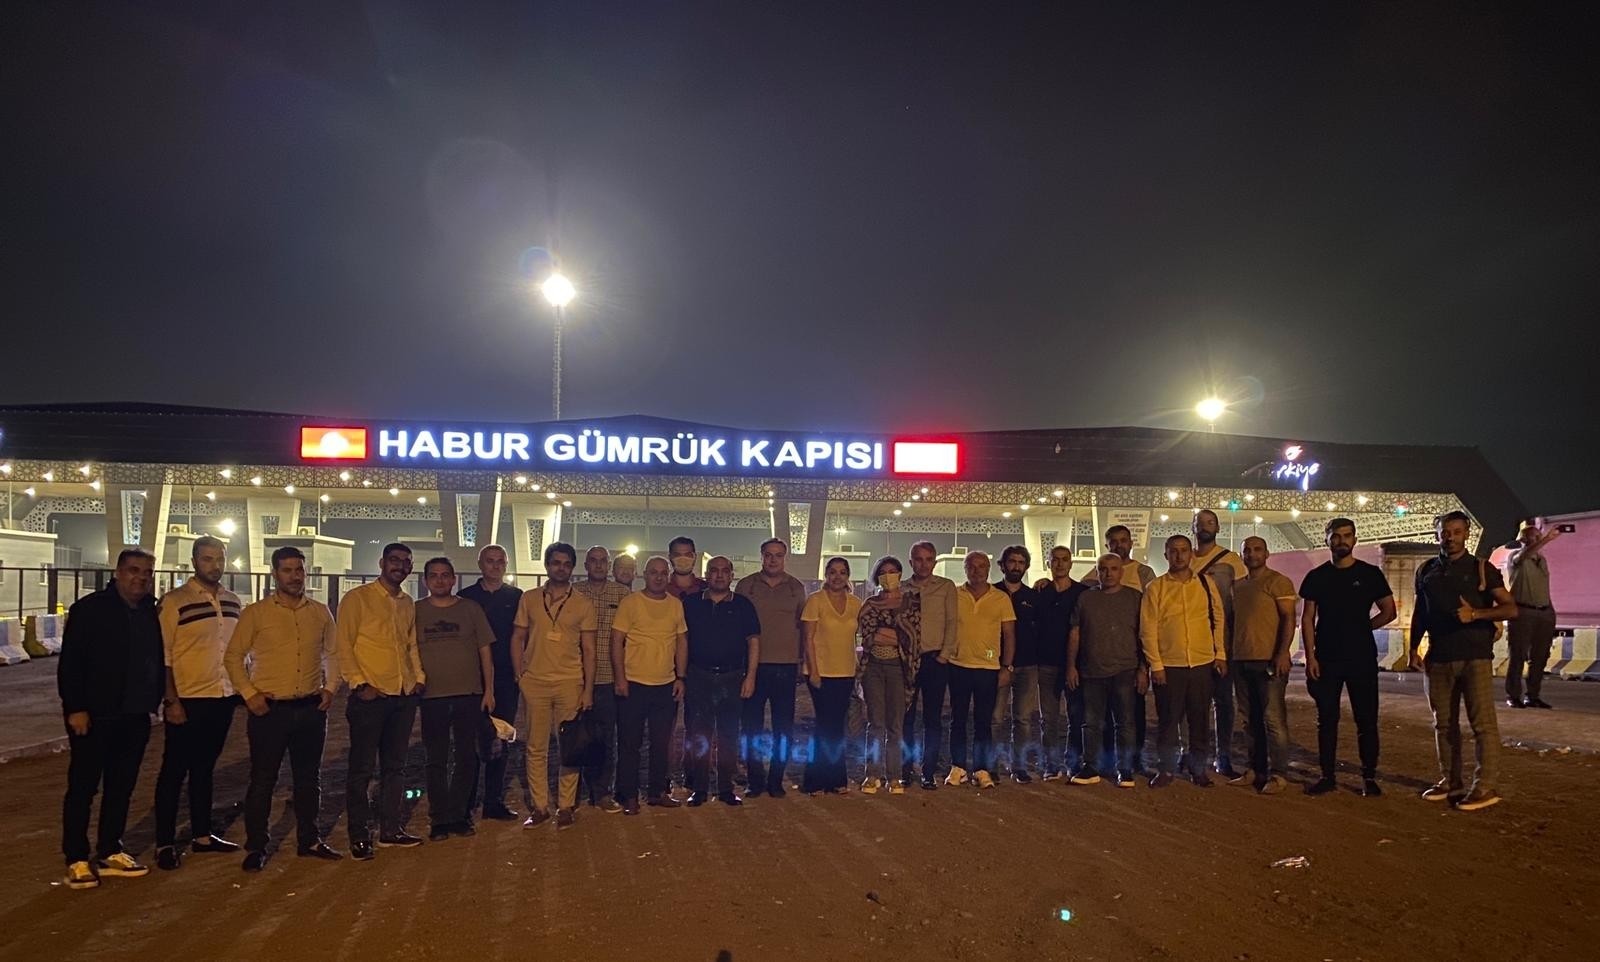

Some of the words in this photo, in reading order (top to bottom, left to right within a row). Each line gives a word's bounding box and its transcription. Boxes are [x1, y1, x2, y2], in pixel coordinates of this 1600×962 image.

[378, 429, 530, 460] HABUR
[543, 428, 727, 466] GÜMRÜK
[740, 439, 883, 470] KAPISI
